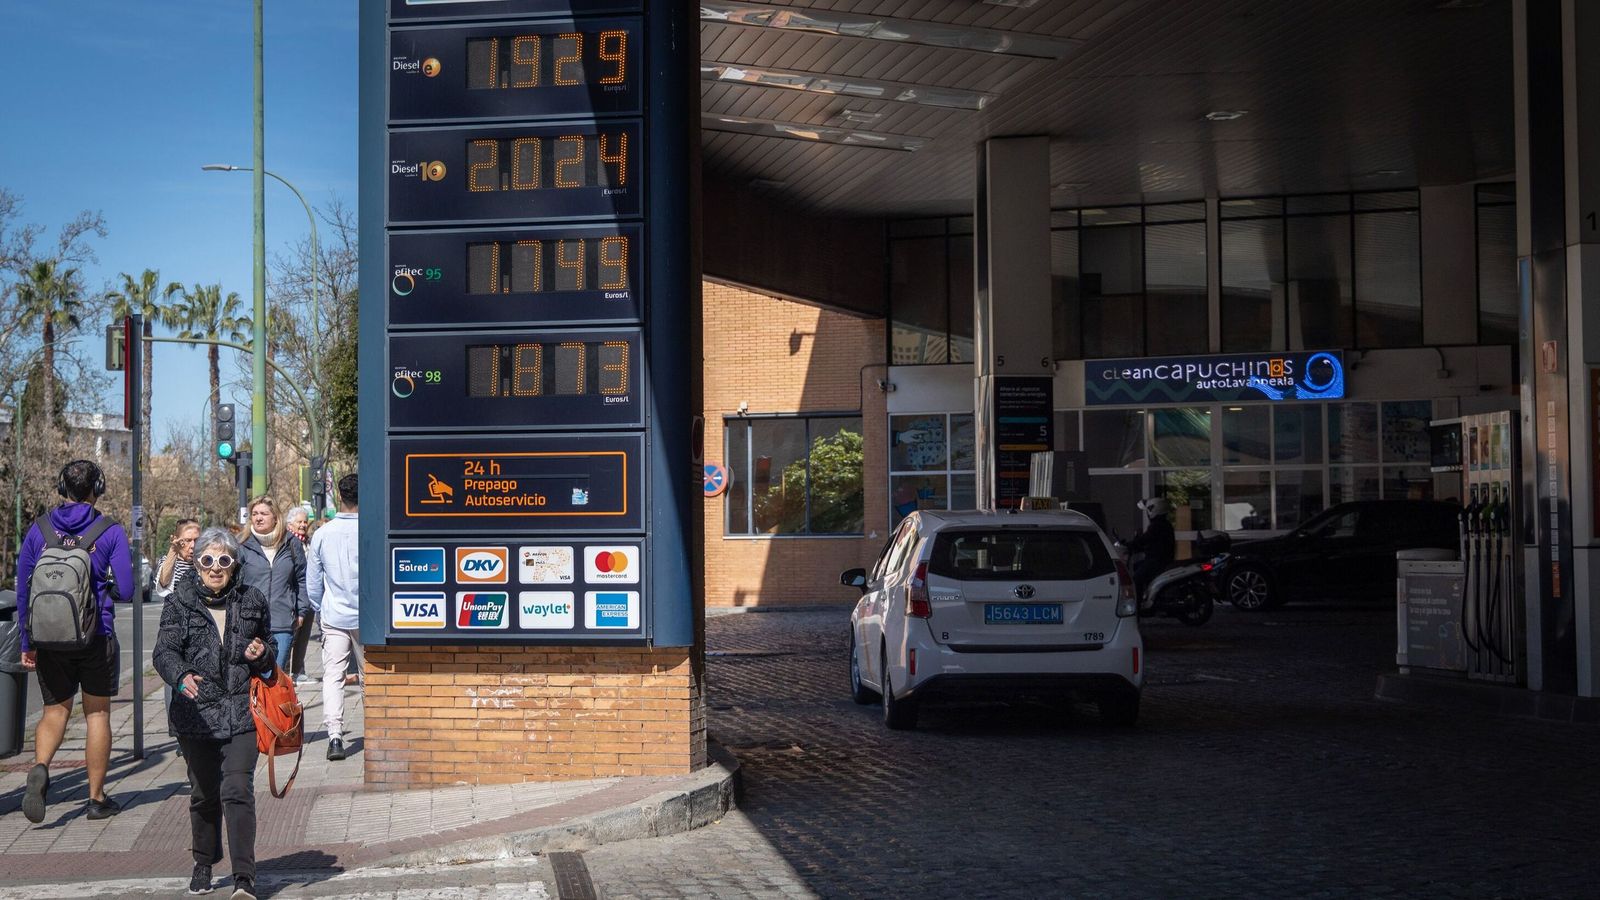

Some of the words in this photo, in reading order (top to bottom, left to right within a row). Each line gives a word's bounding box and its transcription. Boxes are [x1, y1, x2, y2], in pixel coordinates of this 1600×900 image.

[393, 59, 420, 71] Diesel
[488, 30, 628, 89] 1.929
[468, 132, 628, 192] 2.024
[392, 163, 418, 174] Diesel
[1586, 211, 1596, 231] 1
[489, 236, 629, 294] 1.749
[394, 267, 424, 277] efitec
[425, 268, 442, 280] 95
[604, 291, 629, 300] Euros/l
[997, 355, 1005, 367] 5
[1041, 357, 1049, 368] 6
[490, 341, 630, 397] 1.873
[394, 369, 424, 379] efitec
[425, 370, 441, 383] 98
[604, 396, 629, 404] Euros/l
[1039, 425, 1047, 437] 5
[464, 461, 485, 476] 24
[490, 459, 500, 475] h
[464, 478, 517, 493] Prepago
[464, 493, 546, 507] Autoservicio
[1032, 499, 1051, 510] TAXI
[398, 563, 428, 572] Solred
[463, 559, 500, 571] DKV
[400, 603, 439, 617] VISA
[463, 601, 504, 613] UnionPay
[522, 603, 569, 617] waylet
[994, 607, 1029, 620] 5643
[1033, 607, 1060, 621] LCM
[942, 632, 949, 640] B
[1083, 632, 1104, 641] 1789
